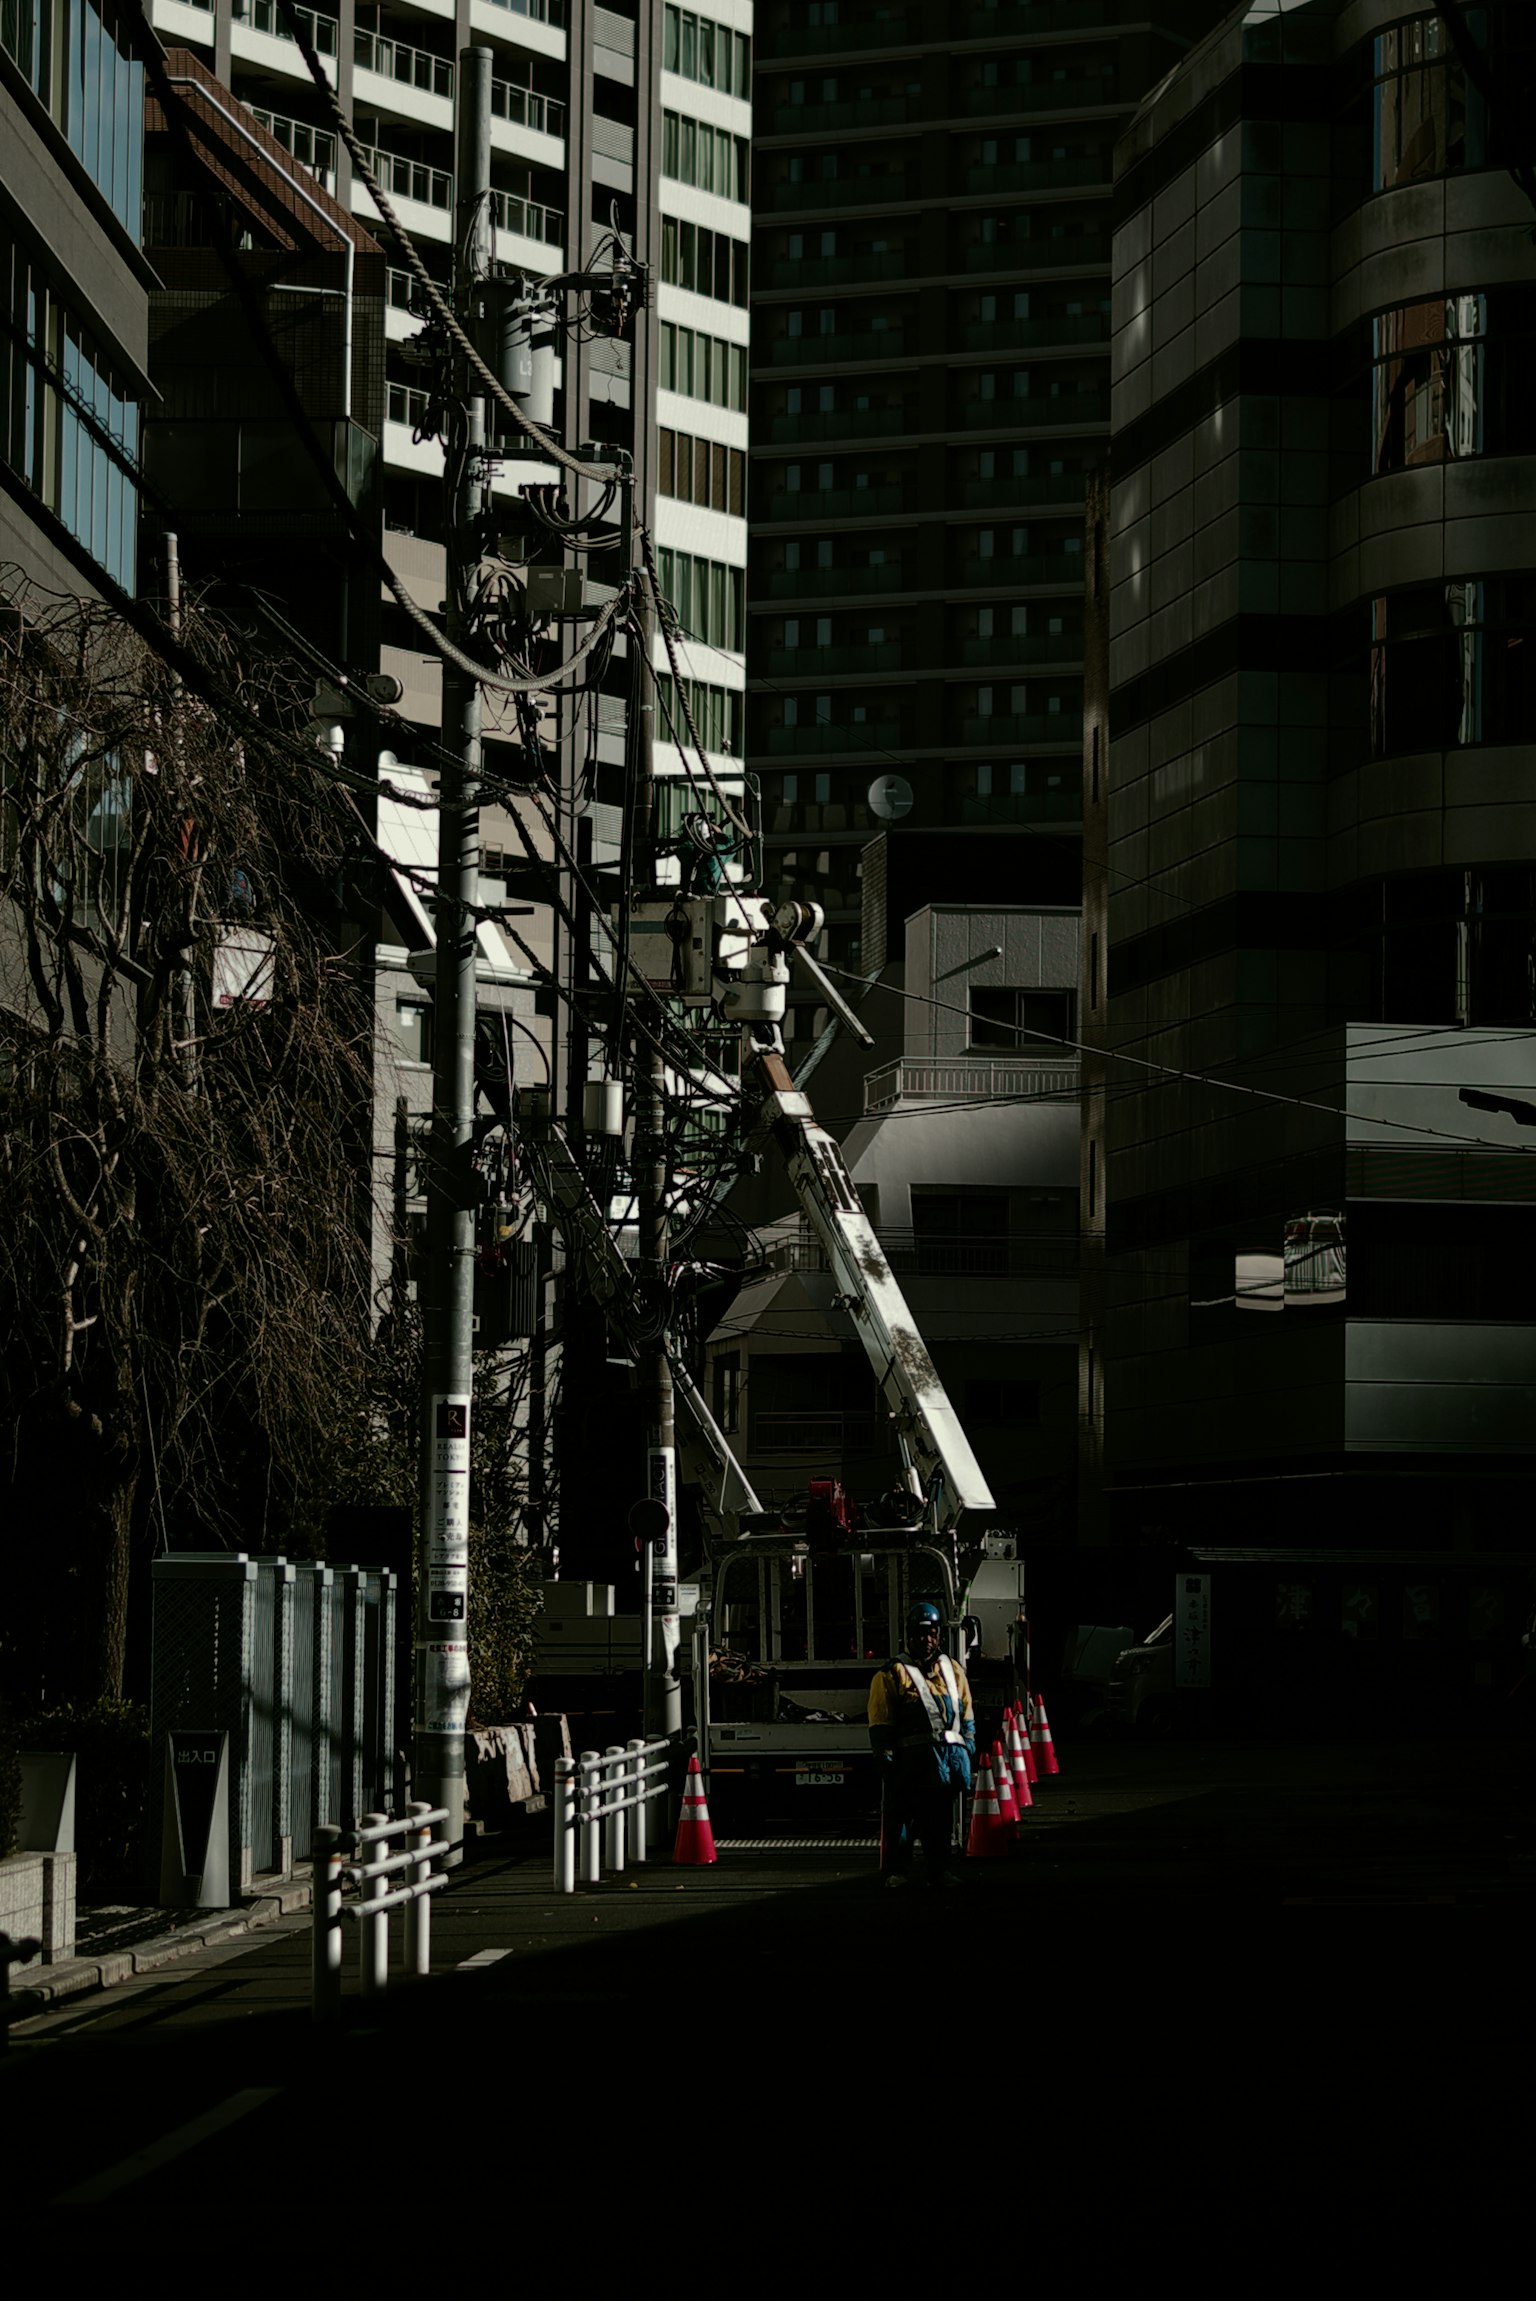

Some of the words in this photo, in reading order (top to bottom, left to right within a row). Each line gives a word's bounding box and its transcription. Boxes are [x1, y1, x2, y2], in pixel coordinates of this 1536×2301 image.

[447, 1409, 463, 1427] R
[177, 1749, 216, 1764] 出入口
